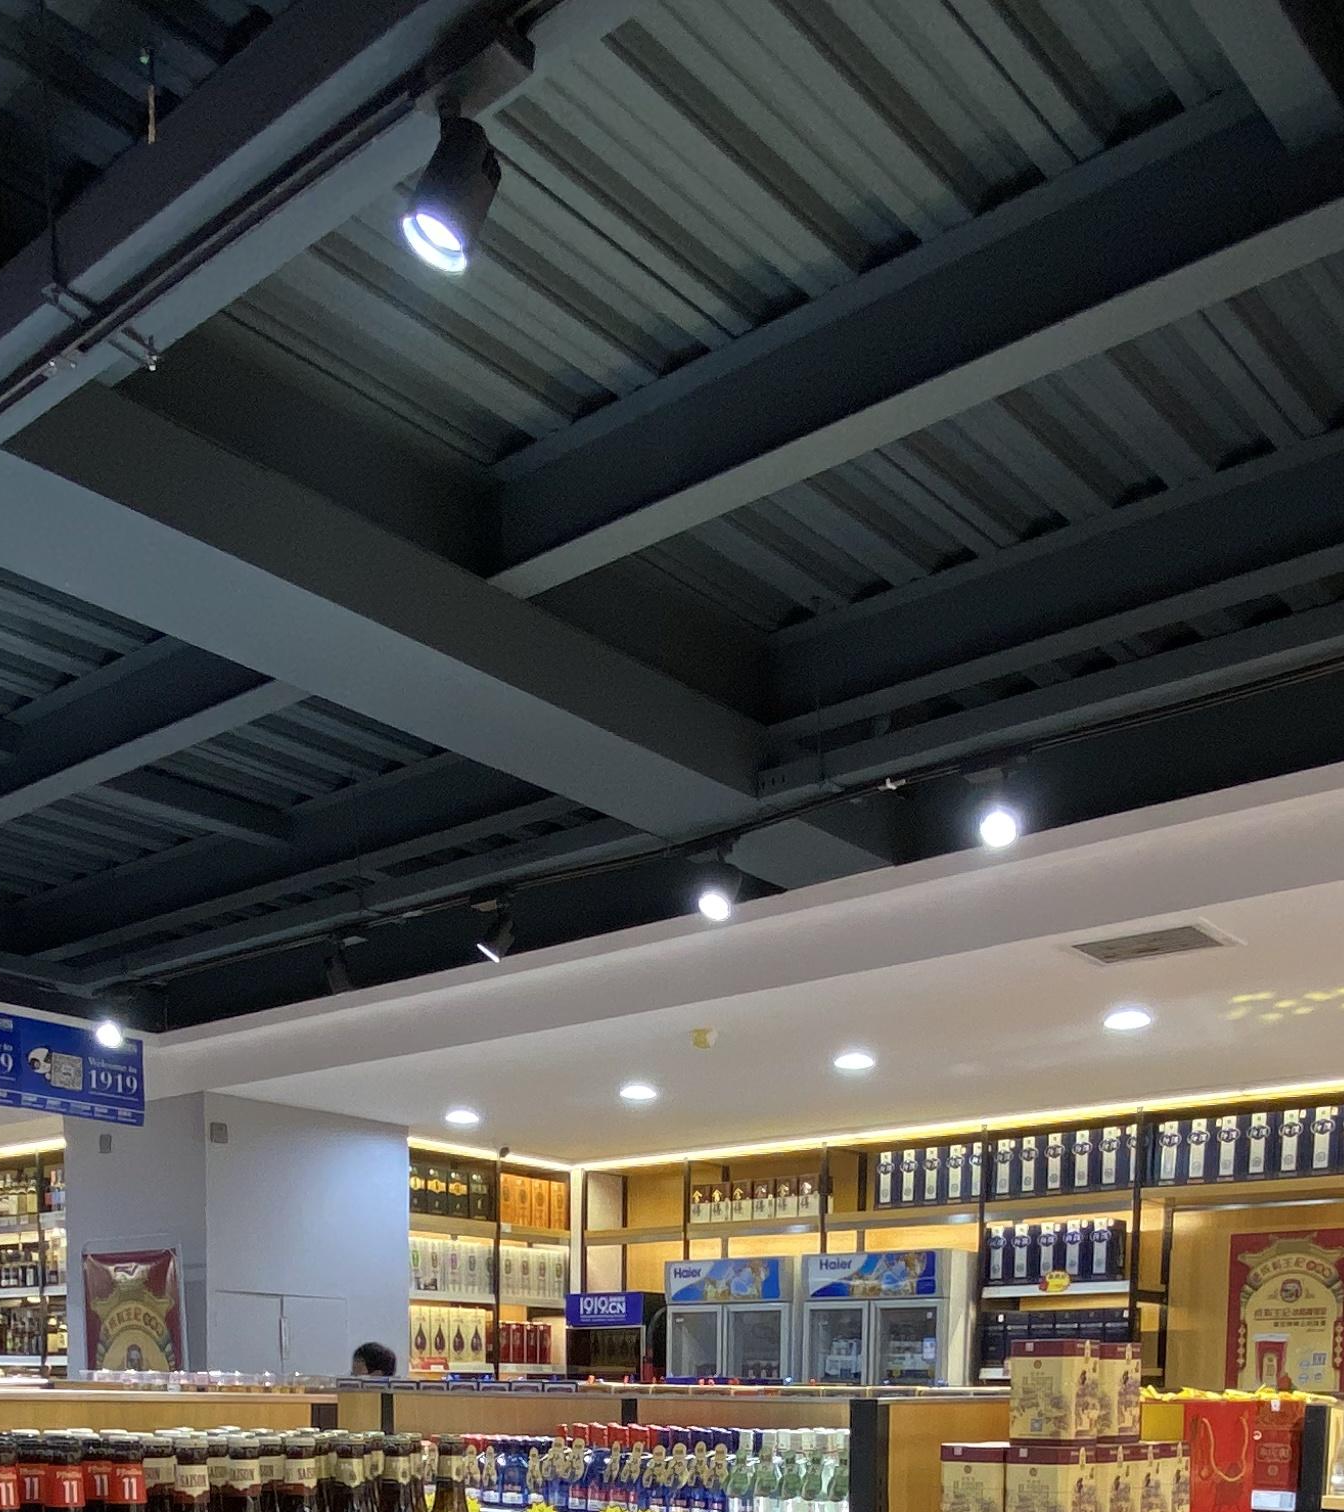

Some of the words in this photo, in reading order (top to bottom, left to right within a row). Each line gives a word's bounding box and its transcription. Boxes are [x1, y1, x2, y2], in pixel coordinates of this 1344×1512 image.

[88, 1070, 138, 1094] 1919
[819, 1257, 853, 1270] Haier
[673, 1267, 702, 1279] Haier
[580, 1296, 626, 1314] 1919.CN
